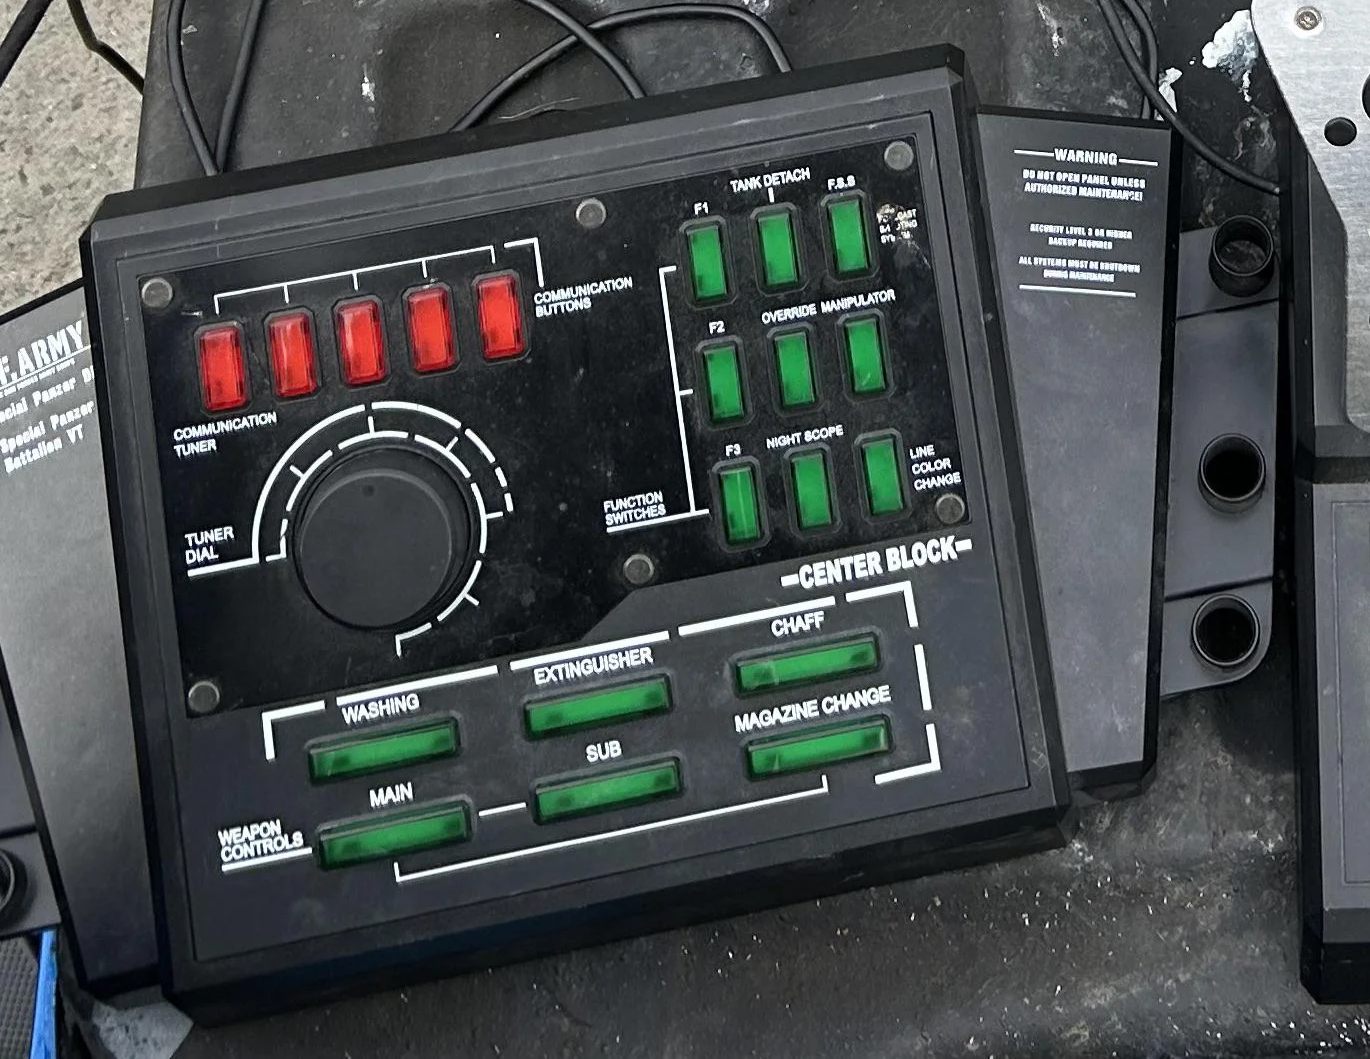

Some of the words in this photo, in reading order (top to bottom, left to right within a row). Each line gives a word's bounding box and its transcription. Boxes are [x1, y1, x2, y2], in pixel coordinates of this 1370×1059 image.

[1054, 148, 1119, 166] WARNING
[729, 175, 763, 193] TANK
[762, 166, 811, 188] DETACH
[1022, 168, 1036, 179] DO
[1037, 169, 1056, 181] NOT
[1055, 171, 1081, 184] OPEN
[1081, 173, 1110, 186] PANEL
[1110, 176, 1146, 189] UNLESS
[1023, 181, 1078, 197] AUTHORIZED
[693, 201, 709, 216] F1
[1018, 256, 1033, 266] ALL
[533, 276, 633, 305] COMMUNICATION
[535, 296, 592, 318] BUTTONS
[761, 302, 818, 325] OVERRIDE
[820, 288, 896, 314] MANIPULATOR
[709, 320, 726, 335] F2
[32, 376, 77, 408] Panzer
[0, 420, 46, 454] Special
[49, 400, 95, 431] Panzer
[173, 411, 278, 442] COMMUNICATION
[766, 432, 803, 450] NIGHT
[804, 424, 844, 443] SCOPE
[4, 436, 63, 474] Battalion
[66, 423, 84, 444] VT
[173, 438, 217, 459] TUNER
[725, 443, 741, 457] F3
[909, 444, 936, 459] LINE
[911, 458, 952, 475] COLOR
[913, 471, 962, 491] CHANGE
[603, 490, 664, 513] FUNCTION
[605, 503, 667, 526] SWITCHES
[184, 525, 235, 547] TUNER
[184, 545, 219, 565] DIAL
[771, 610, 825, 638] CHAFF
[533, 646, 655, 686] EXTINGUISHER
[341, 693, 420, 725] WASHING
[734, 698, 820, 734] MAGAZINE
[821, 684, 893, 713] CHANGE
[585, 740, 623, 764] SUB
[368, 782, 415, 808] MAIN
[217, 819, 282, 847] WEAPON
[220, 831, 305, 863] CONTROLS
